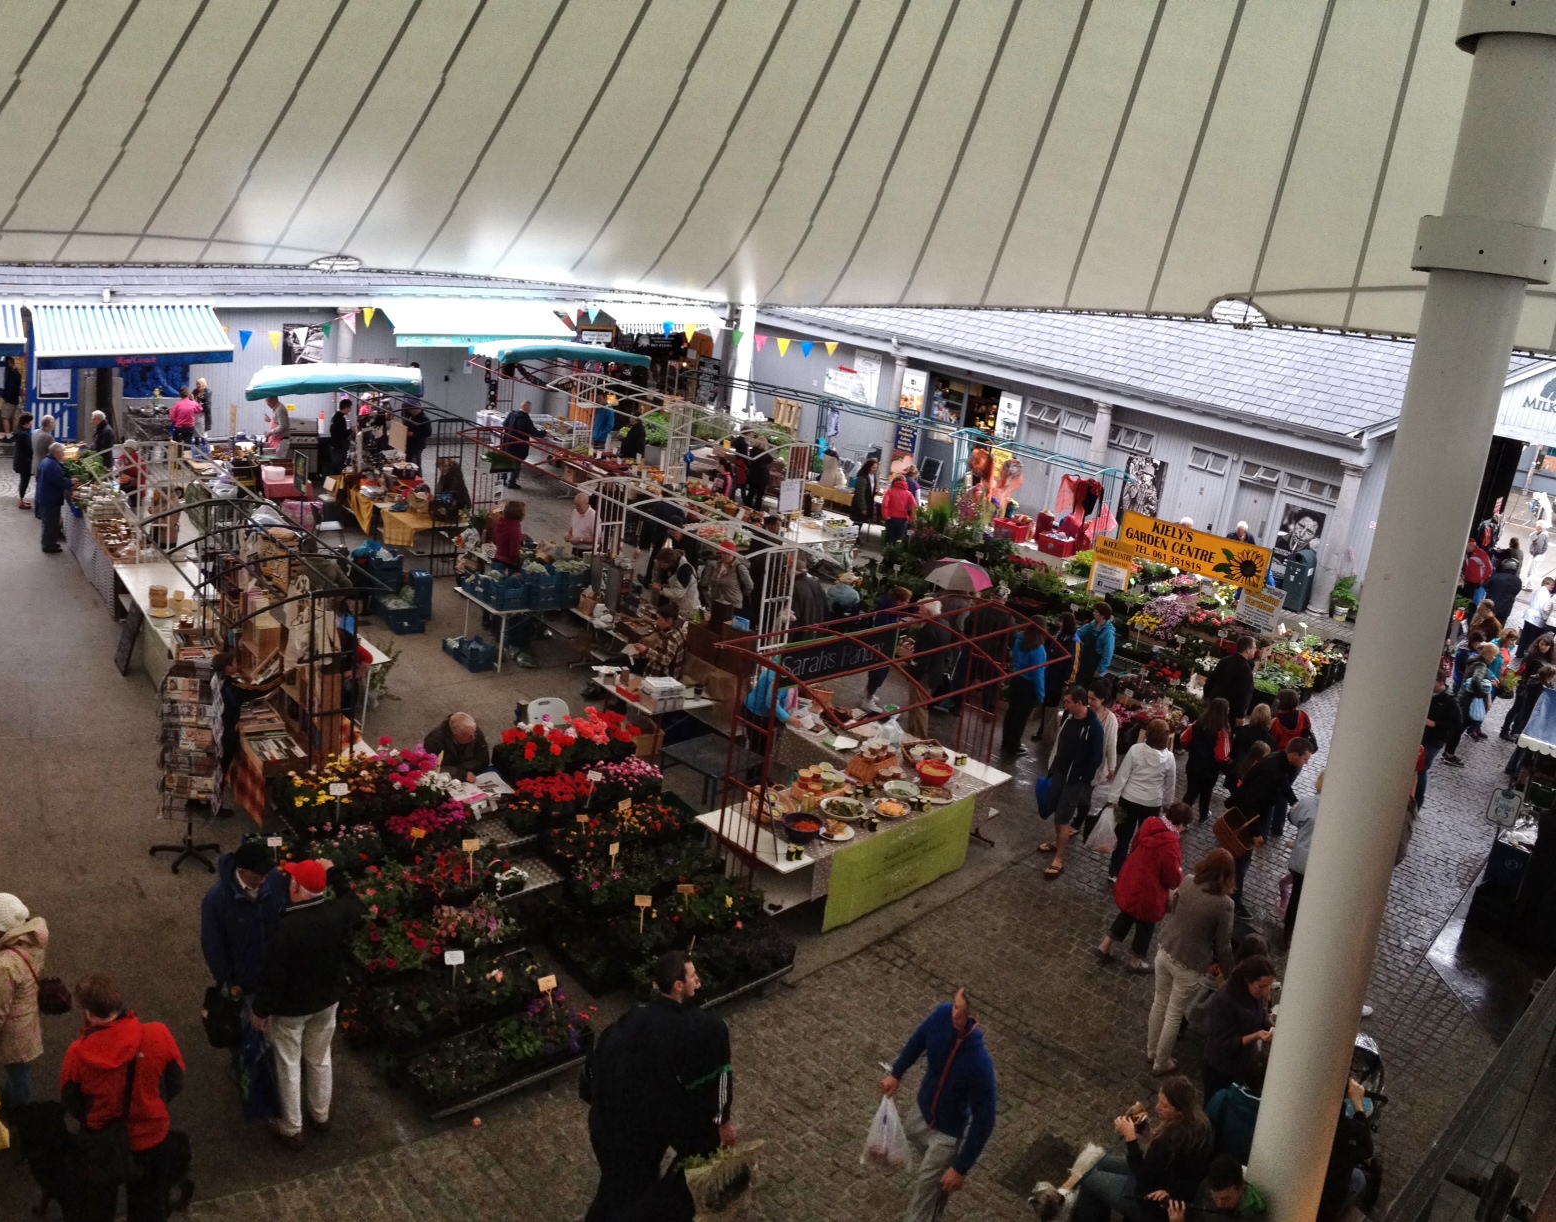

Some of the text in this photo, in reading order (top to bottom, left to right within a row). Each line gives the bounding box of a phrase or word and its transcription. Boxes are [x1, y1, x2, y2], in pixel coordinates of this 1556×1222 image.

[1522, 396, 1556, 413] MILK
[1152, 522, 1193, 543] KIELY'S
[1095, 547, 1132, 562] GARDEN CENTRE
[1126, 528, 1216, 564] GARDEN CENTRE
[1135, 544, 1201, 572] TEL. 061 351818
[781, 651, 837, 679] Sarah's
